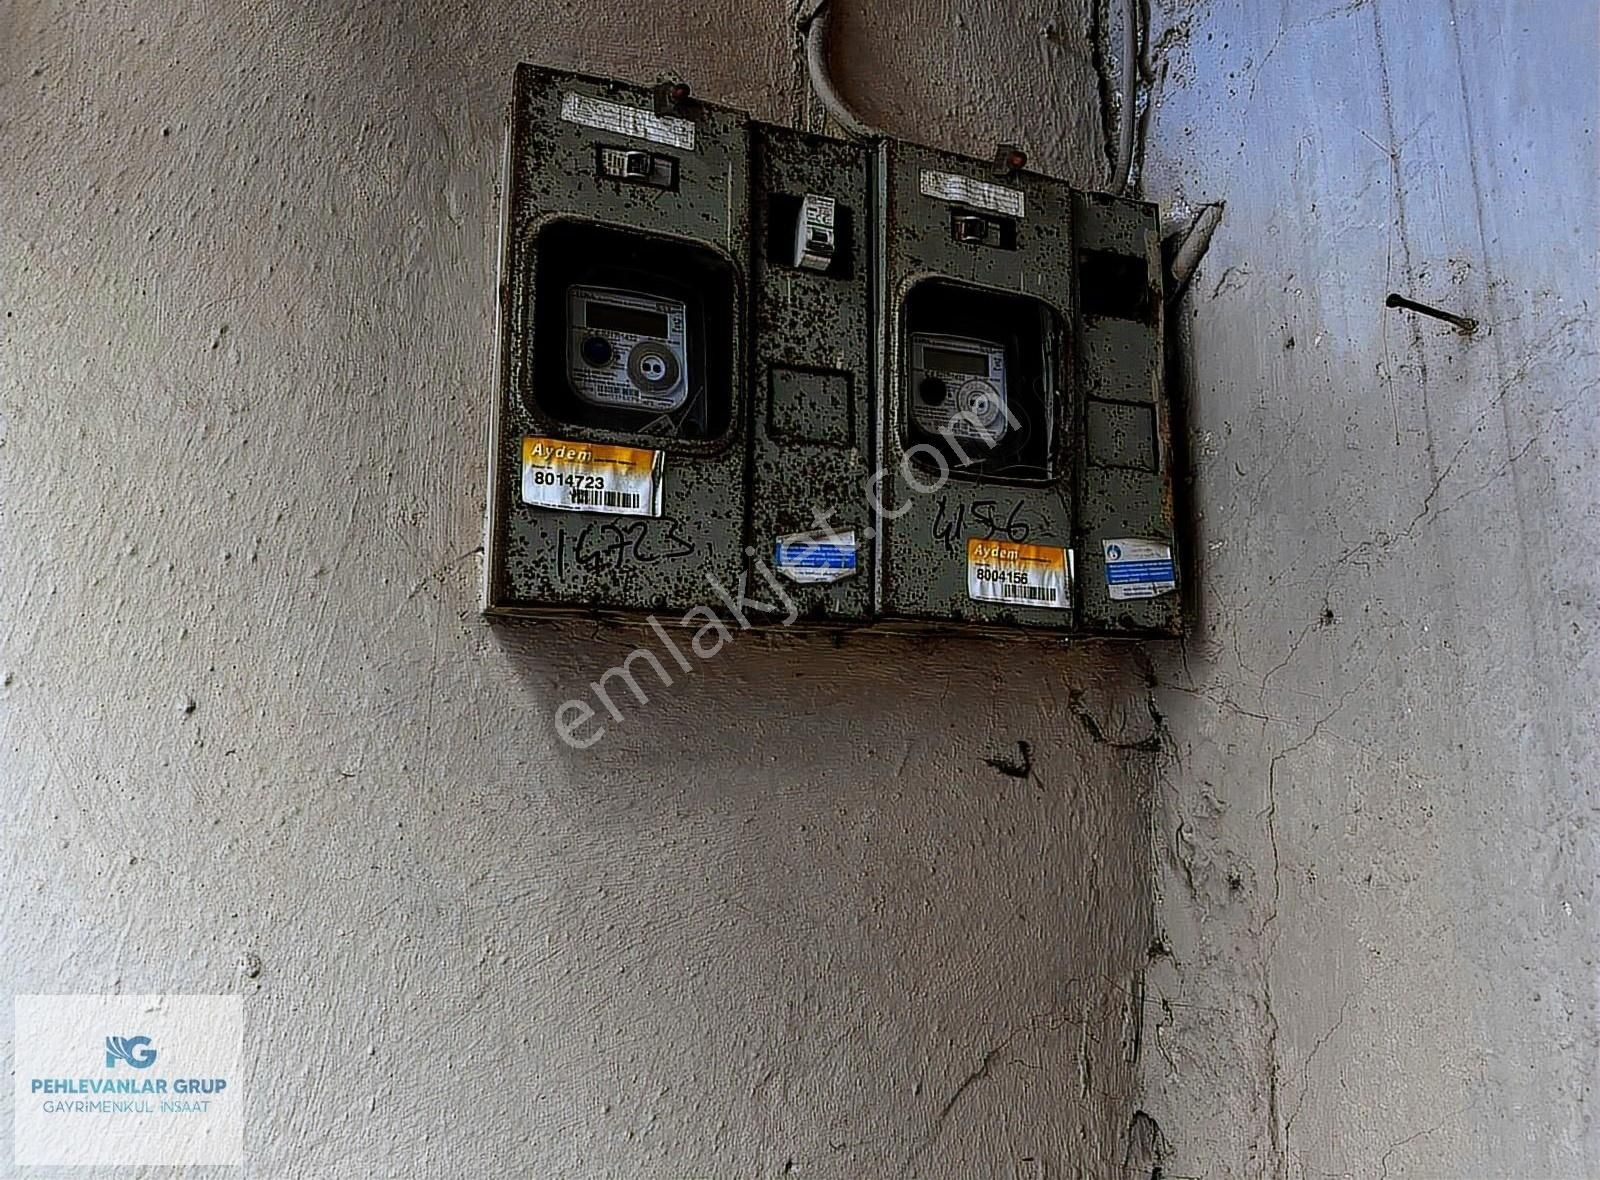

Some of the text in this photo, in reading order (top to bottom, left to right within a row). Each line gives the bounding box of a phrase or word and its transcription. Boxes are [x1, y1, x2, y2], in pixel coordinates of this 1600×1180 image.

[531, 442, 592, 461] Aydem
[534, 471, 605, 490] 8014723
[973, 543, 1020, 561] Aydem
[976, 568, 1028, 585] 8004156
